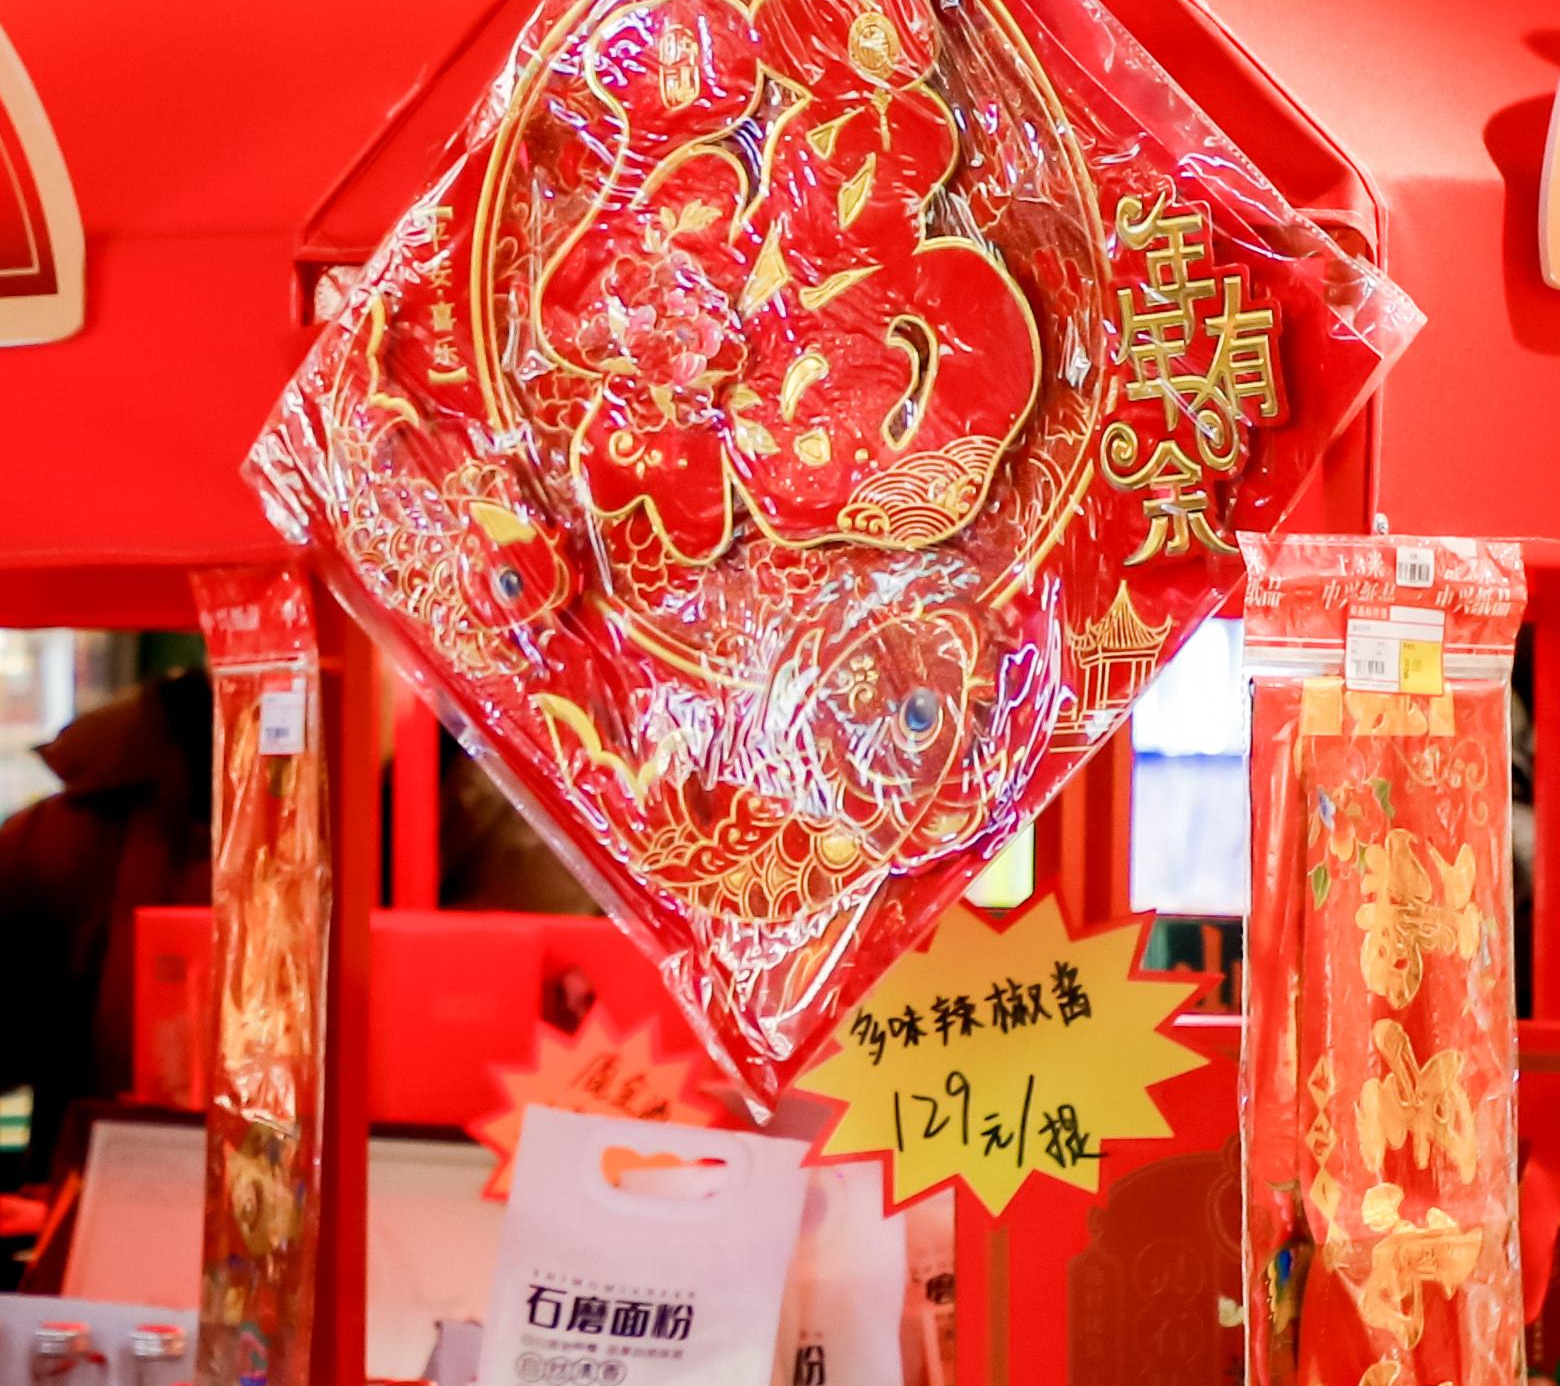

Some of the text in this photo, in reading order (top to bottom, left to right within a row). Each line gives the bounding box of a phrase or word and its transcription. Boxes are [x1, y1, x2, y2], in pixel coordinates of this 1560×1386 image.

[1100, 189, 1279, 566] 年年有余
[849, 960, 1093, 1066] 多味辣椒酱
[526, 1284, 694, 1341] 石磨面粉
